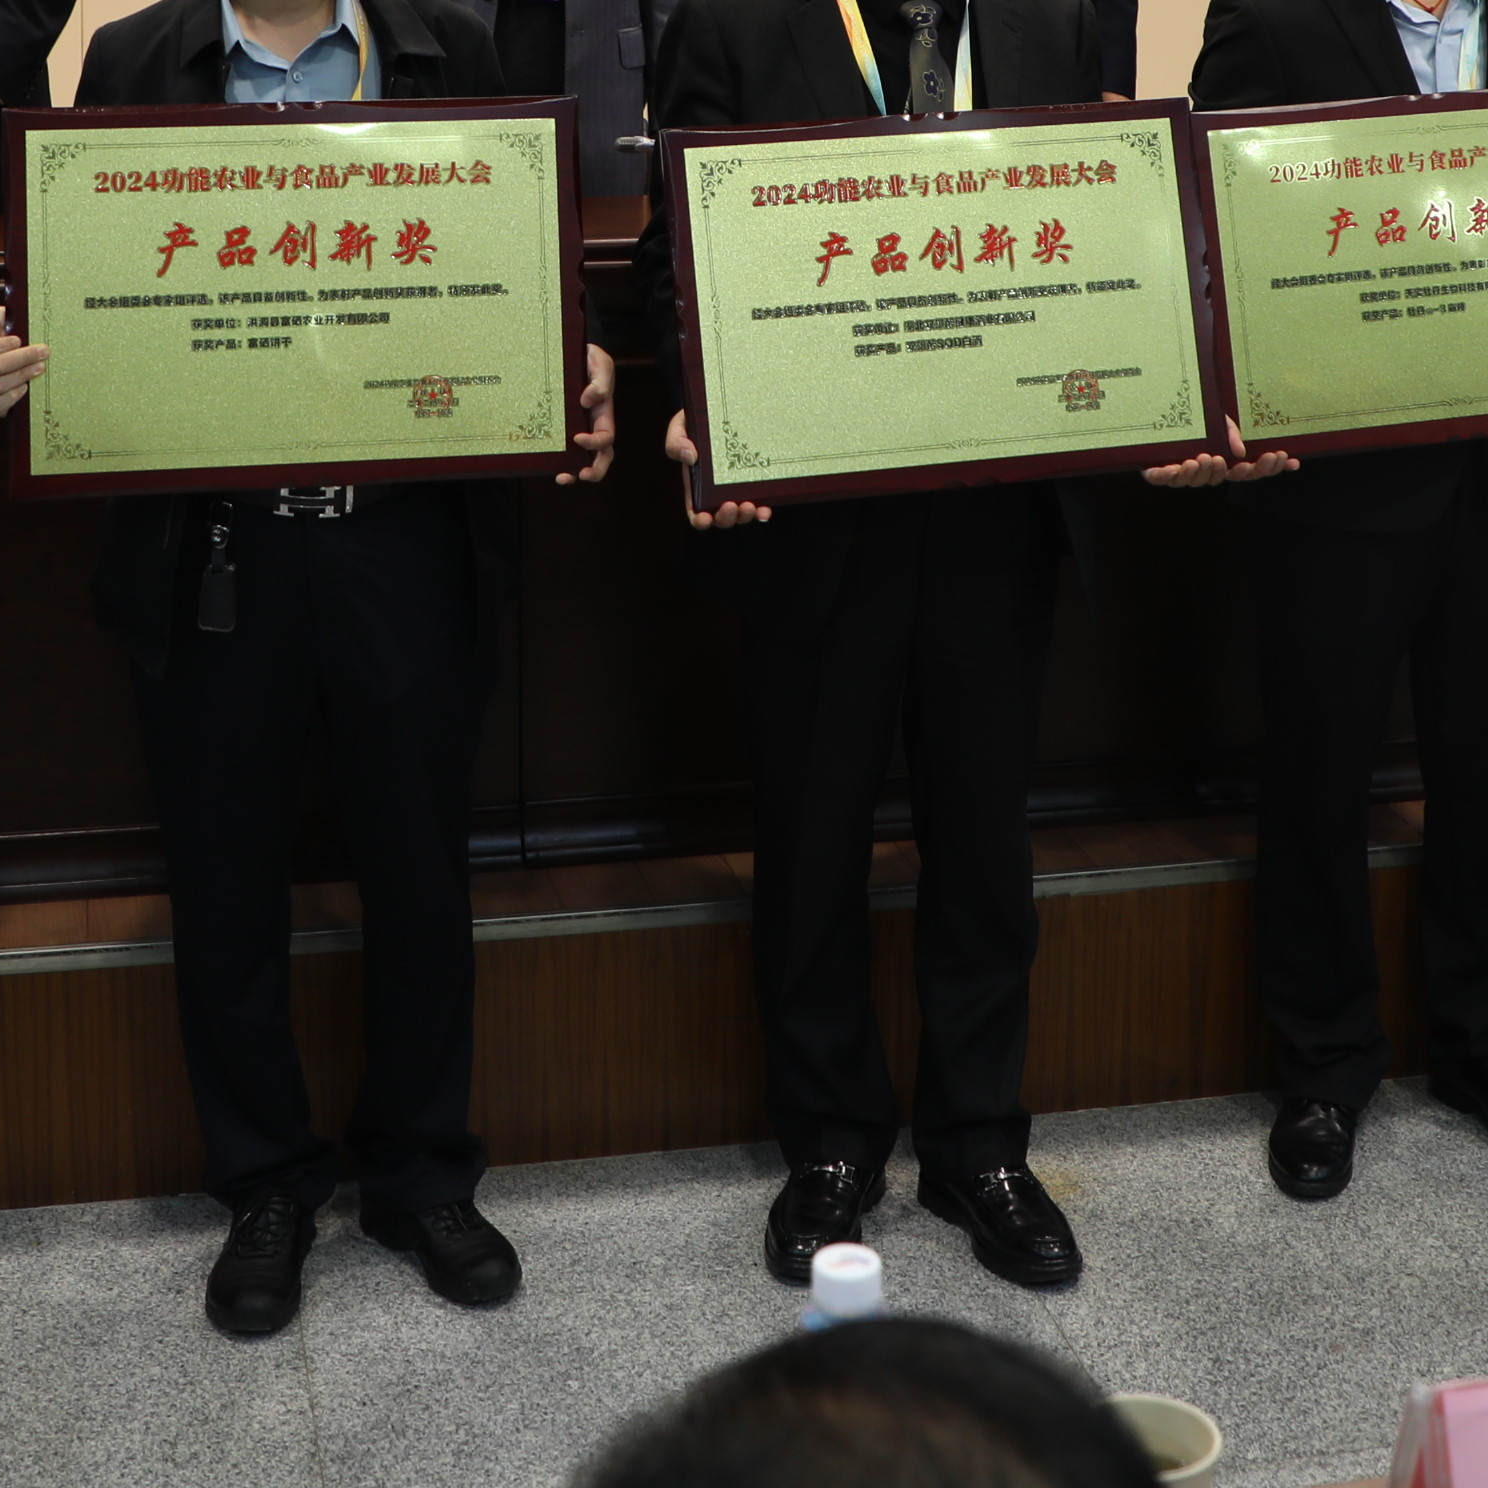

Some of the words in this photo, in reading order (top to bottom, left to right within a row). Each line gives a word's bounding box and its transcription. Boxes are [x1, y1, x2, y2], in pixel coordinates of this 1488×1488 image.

[94, 159, 492, 194] 2024功能农业与食品产业发展大会
[751, 160, 1118, 207] 2024功能农业与食品产业发展大会
[155, 217, 438, 279] 产品创新奖
[816, 218, 1073, 287] 产品创新奖
